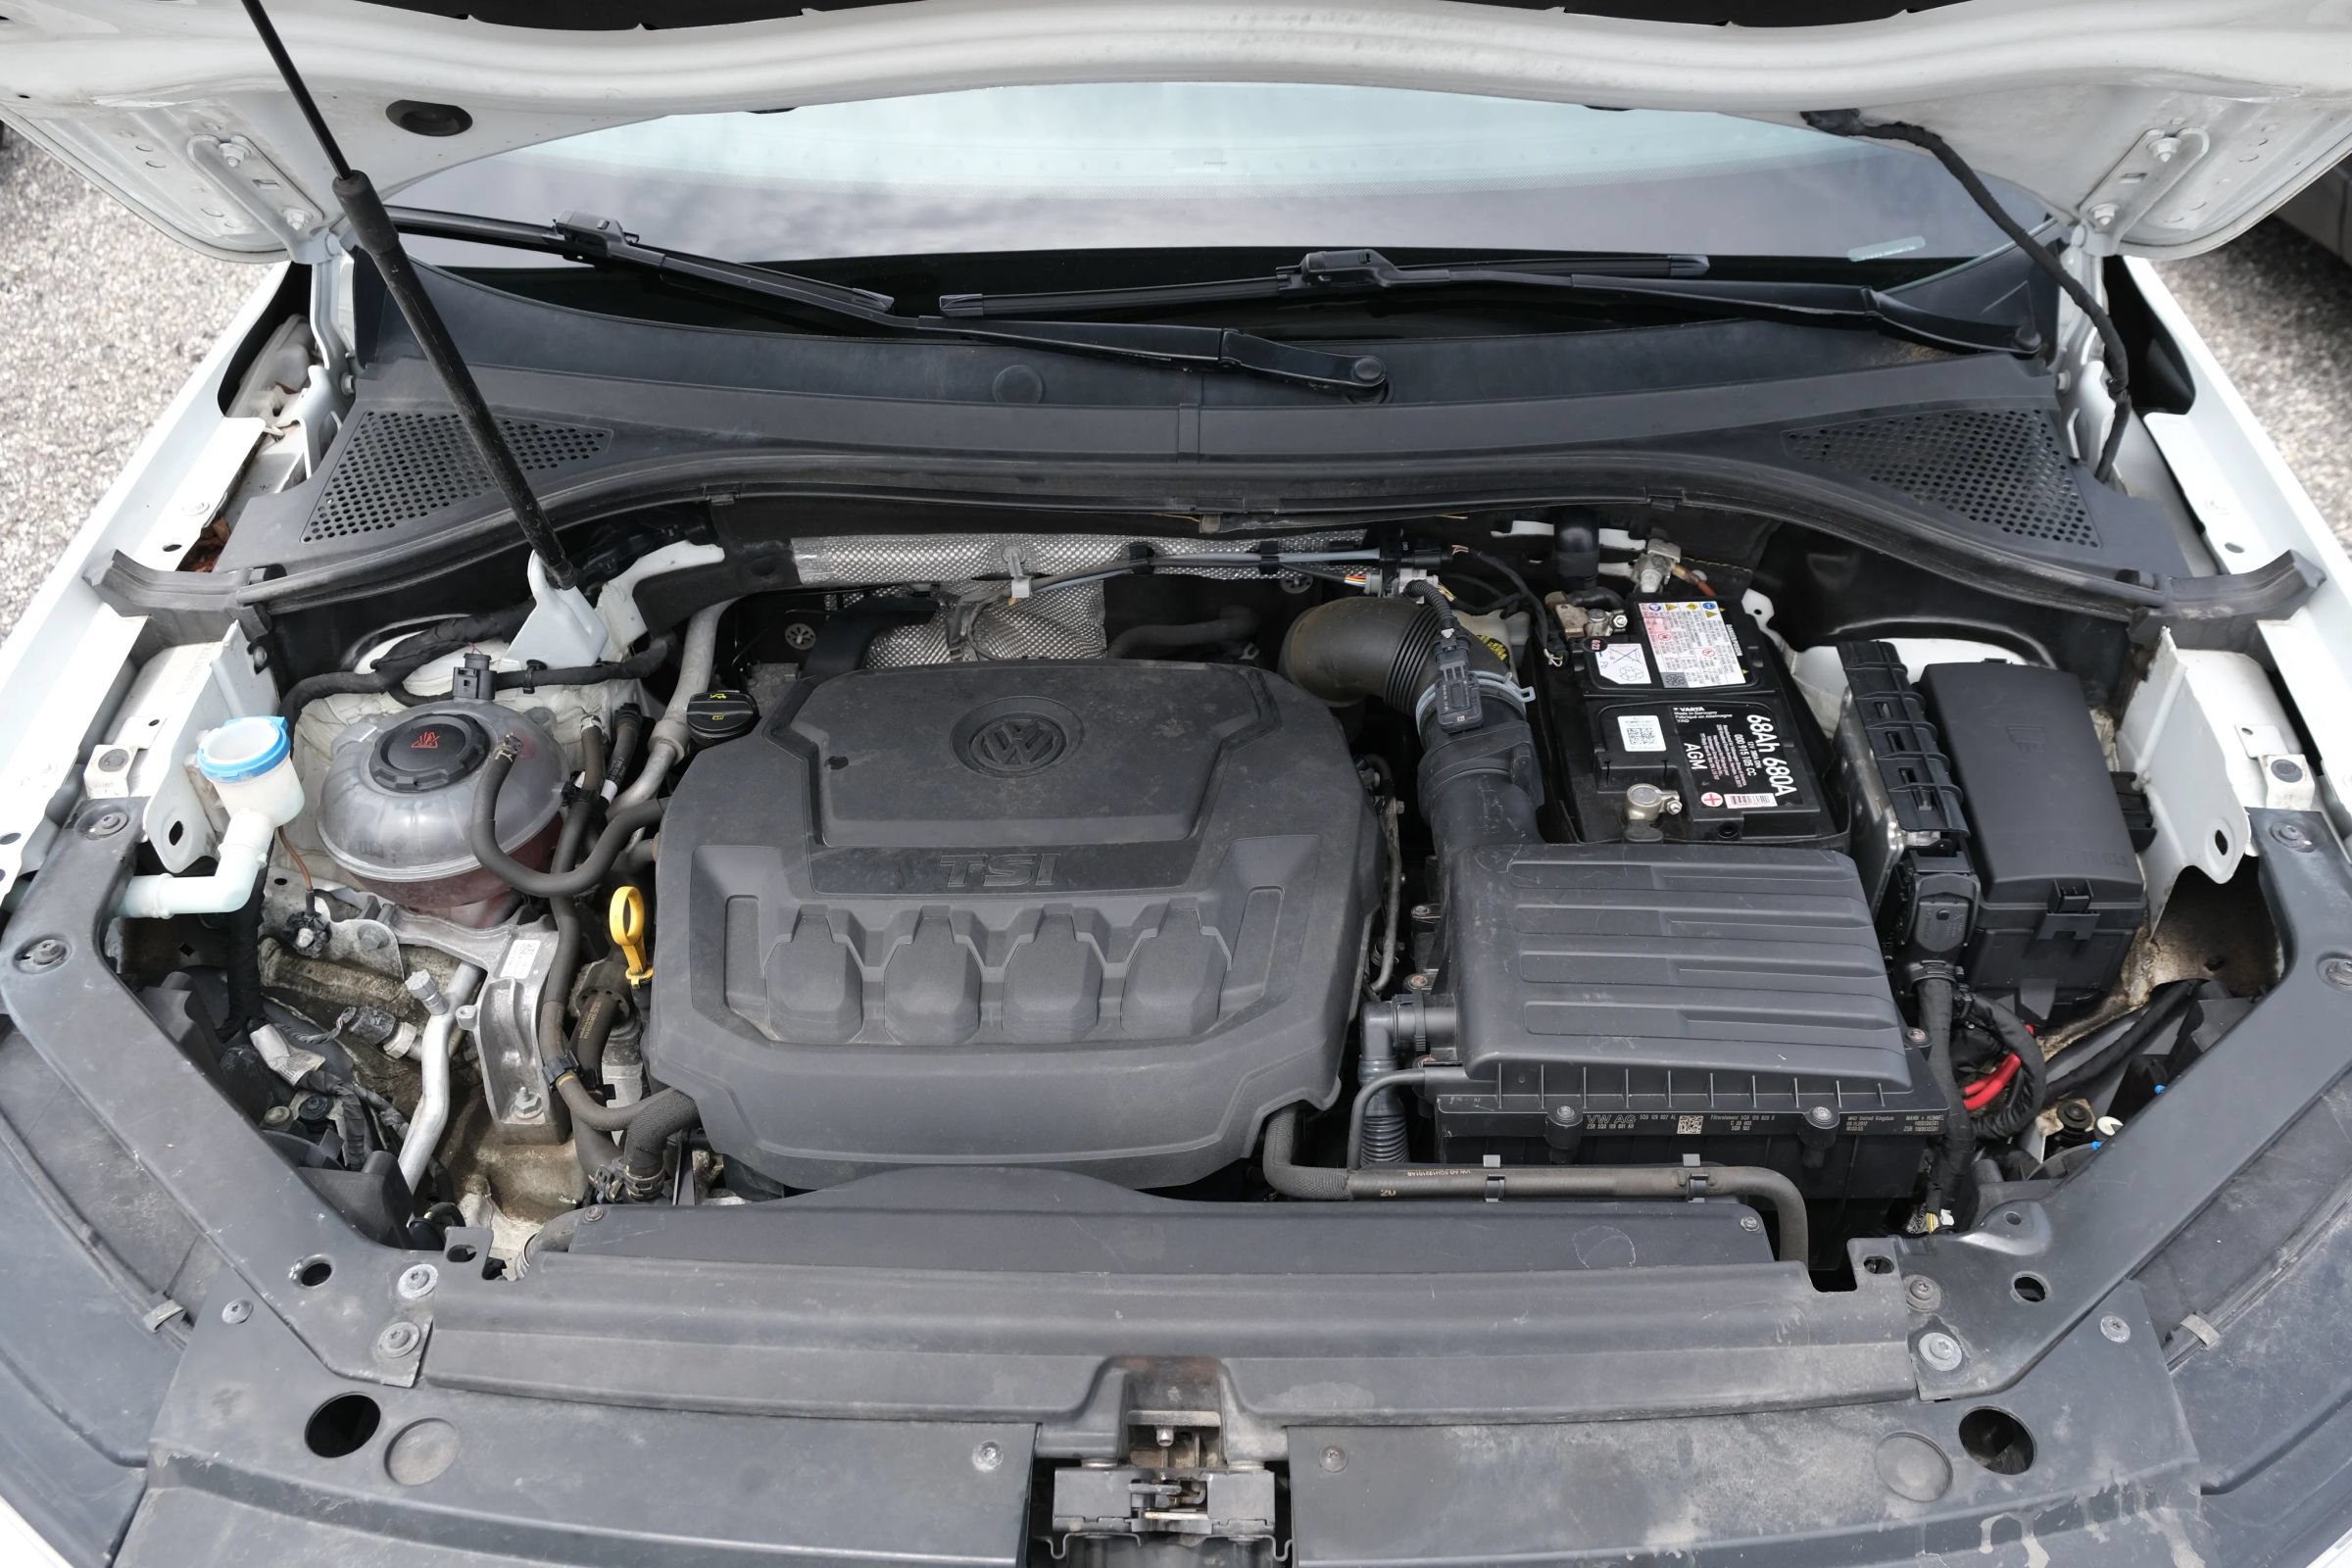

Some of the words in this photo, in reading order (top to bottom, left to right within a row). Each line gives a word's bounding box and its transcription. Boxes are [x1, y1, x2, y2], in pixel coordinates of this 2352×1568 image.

[1747, 714, 1780, 752] 68Ah
[1734, 734, 1745, 745] 000
[1684, 743, 1708, 769] AGM
[1738, 745, 1749, 756] 915
[1742, 756, 1754, 767] 105
[1746, 768, 1757, 776] CC
[1762, 757, 1797, 796] 680A
[940, 853, 1061, 887] TSI
[1587, 1114, 1611, 1124] VW
[1614, 1114, 1636, 1124] AG
